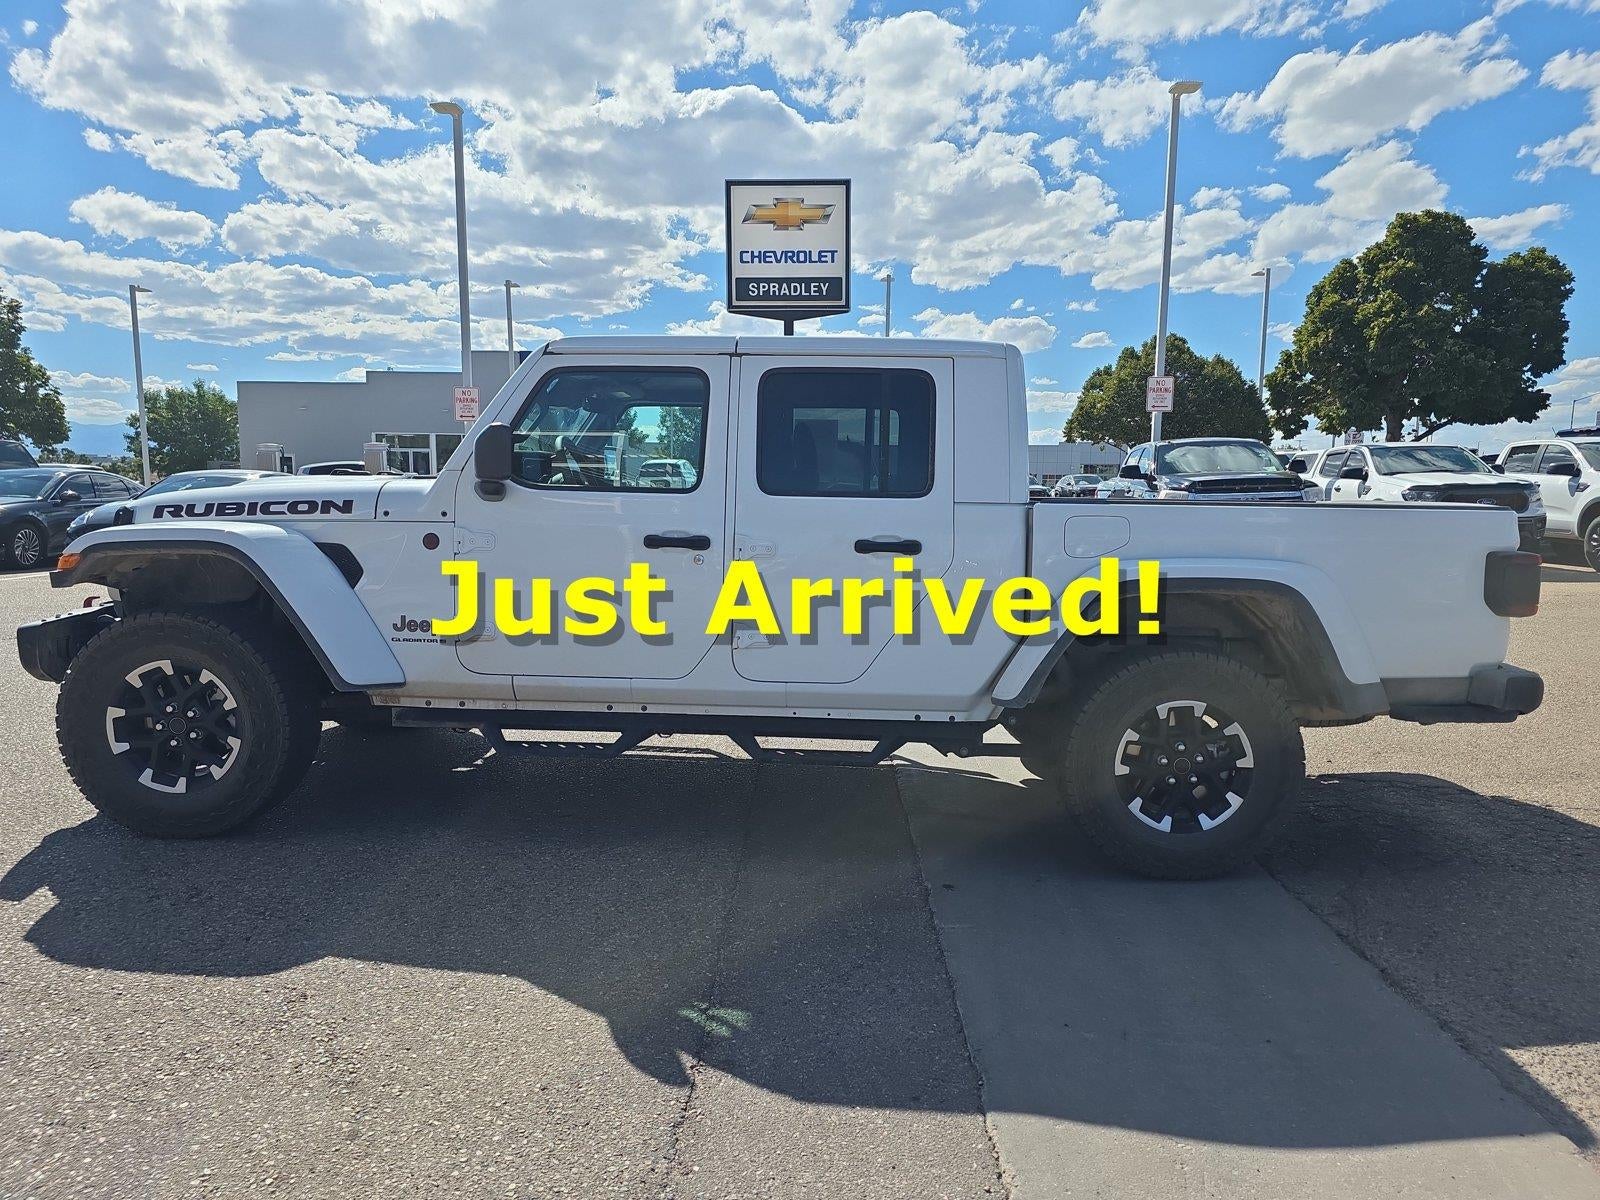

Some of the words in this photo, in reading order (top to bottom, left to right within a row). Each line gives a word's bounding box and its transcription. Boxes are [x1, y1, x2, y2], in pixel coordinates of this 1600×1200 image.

[739, 250, 838, 264] CHEVROLET
[748, 282, 829, 296] SPRADLEY
[152, 499, 354, 519] RUBICON
[392, 615, 436, 636] Jee
